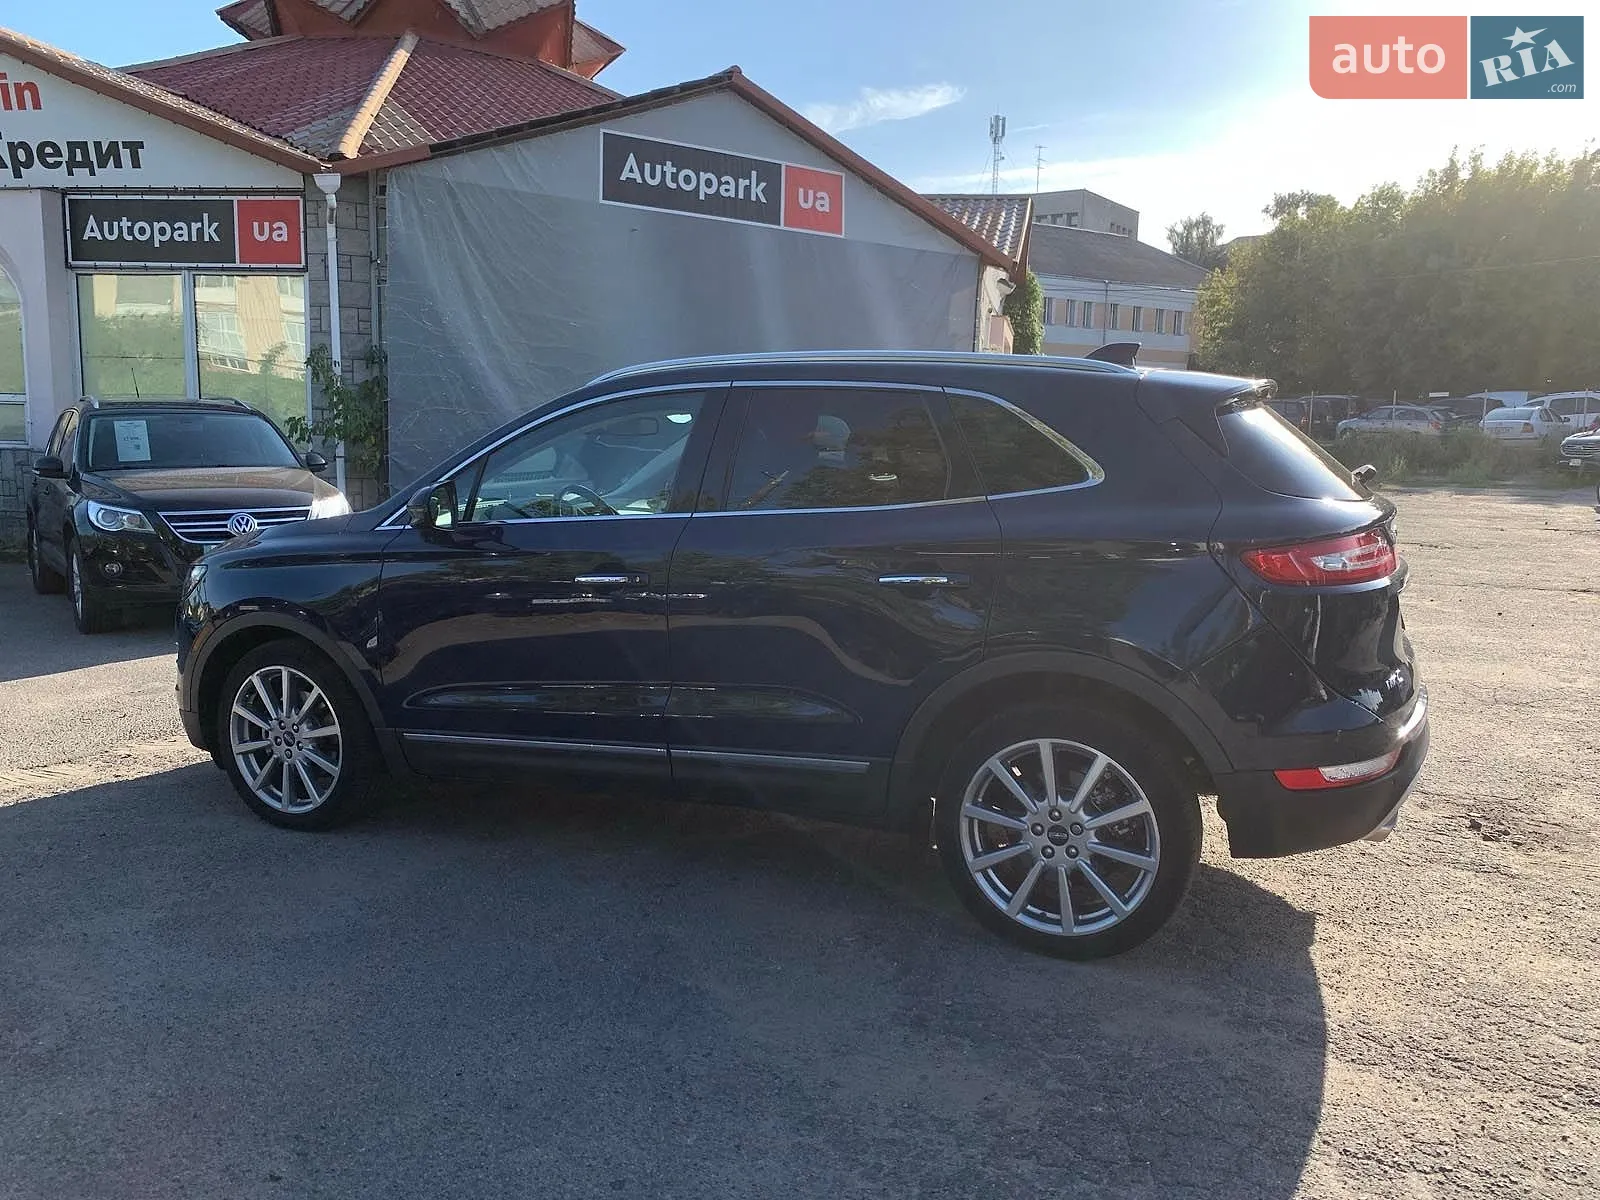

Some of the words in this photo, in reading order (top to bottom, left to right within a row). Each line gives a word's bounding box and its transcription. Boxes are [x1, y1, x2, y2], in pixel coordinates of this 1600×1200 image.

[0, 132, 145, 179] редит
[619, 152, 767, 204] Autopark
[798, 187, 830, 213] ua
[82, 212, 221, 247] Autopark
[252, 221, 289, 242] ua
